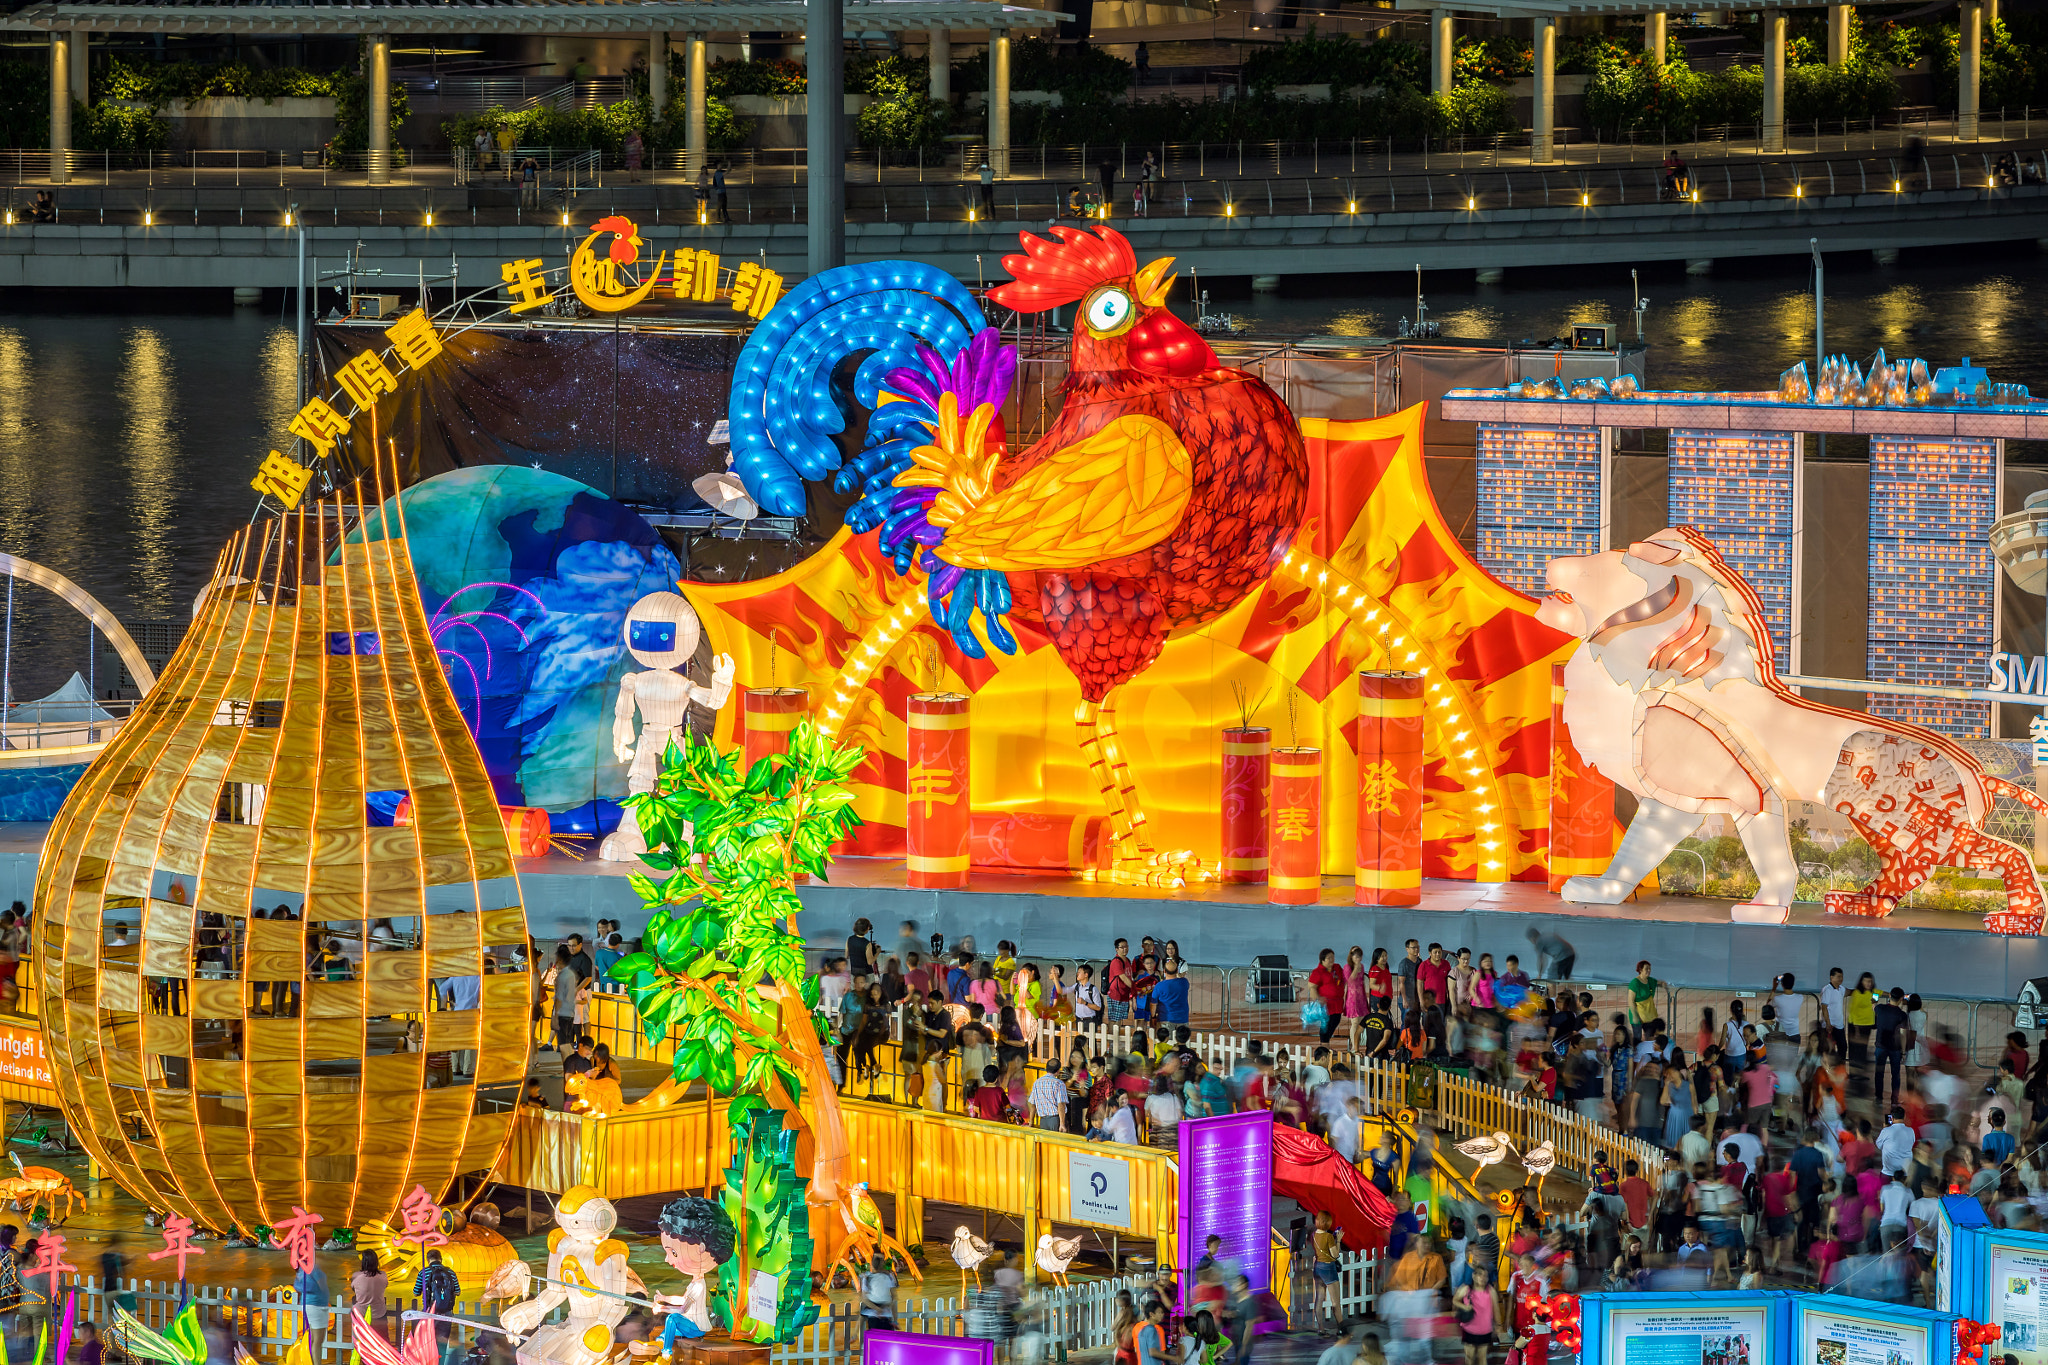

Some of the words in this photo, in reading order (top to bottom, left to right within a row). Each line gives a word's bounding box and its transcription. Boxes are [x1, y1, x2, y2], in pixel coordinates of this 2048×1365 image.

[501, 246, 784, 322] 生机勃勃
[1988, 652, 2048, 696] SM
[908, 760, 961, 820] 年
[1360, 759, 1410, 817] 發
[1275, 806, 1315, 842] 春
[36, 1067, 53, 1083] Res
[1081, 1199, 1103, 1209] Pontiac
[1104, 1203, 1118, 1211] Land
